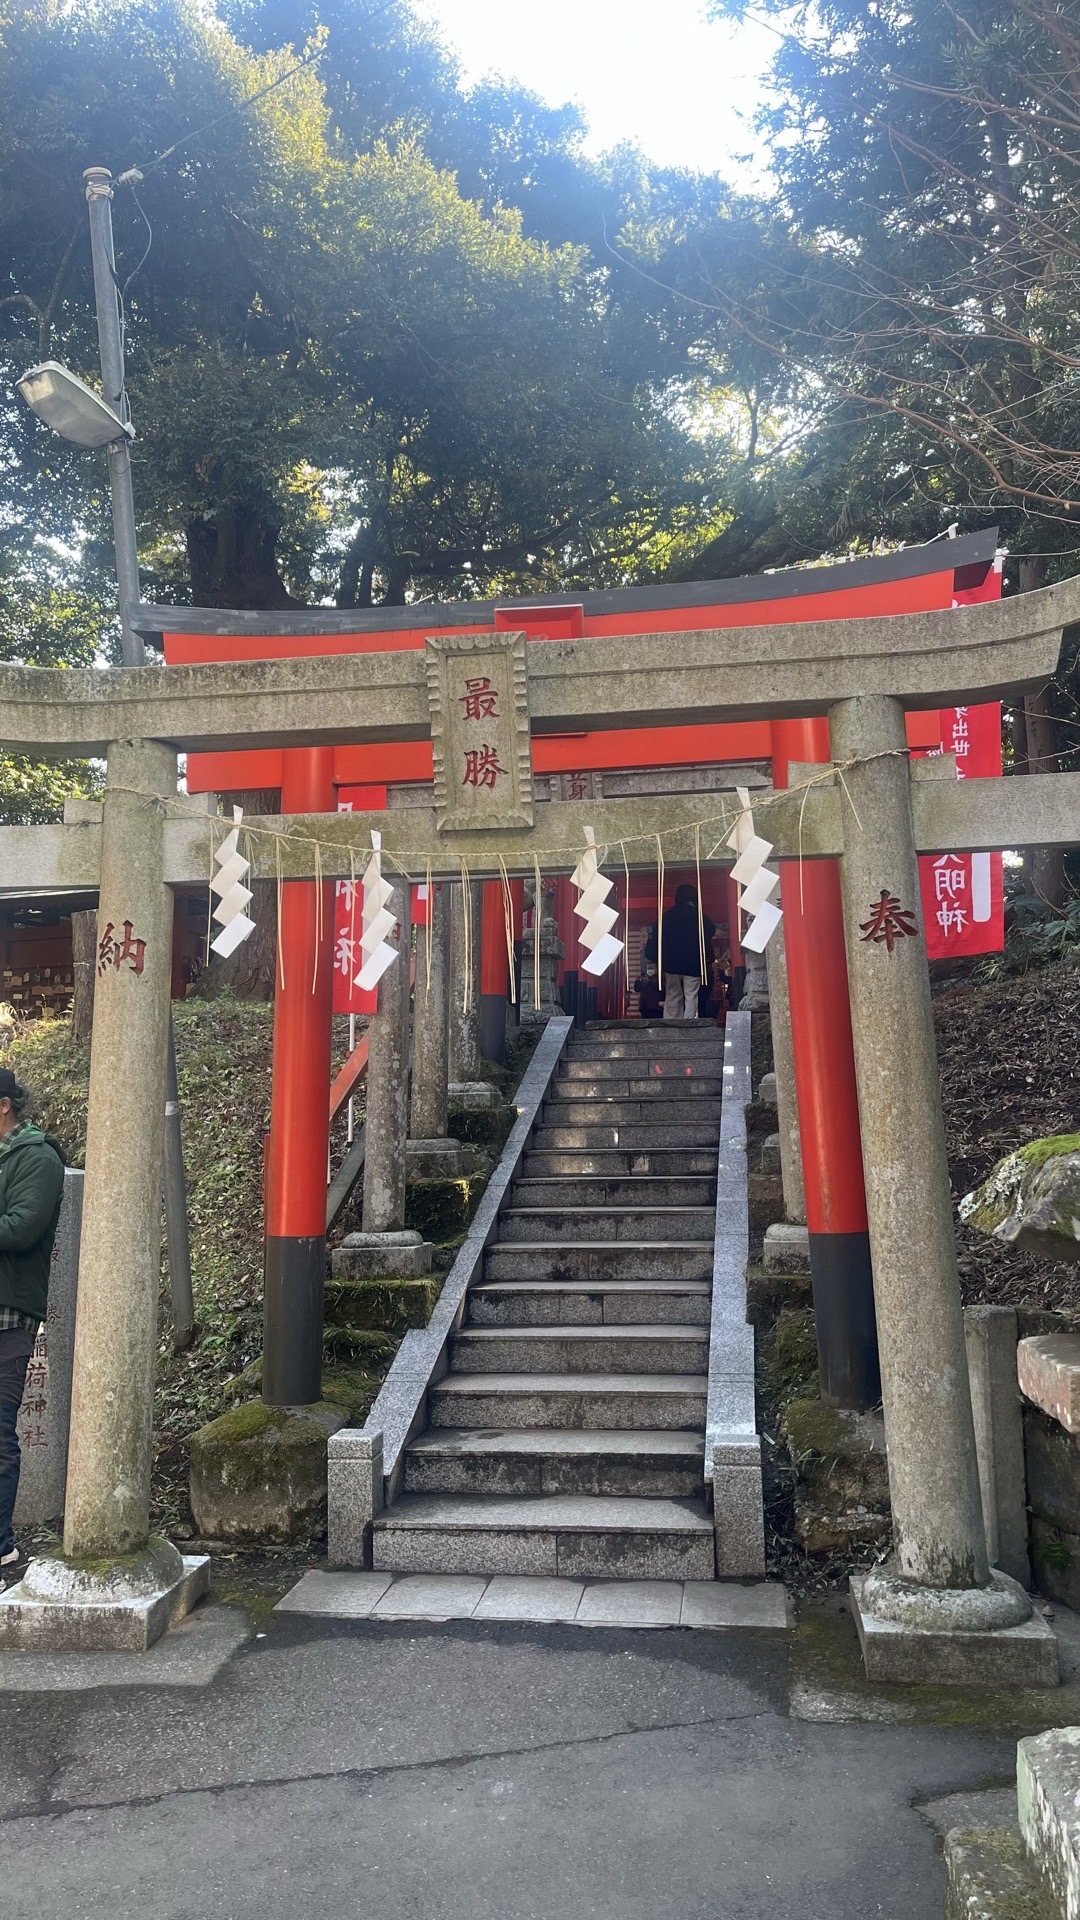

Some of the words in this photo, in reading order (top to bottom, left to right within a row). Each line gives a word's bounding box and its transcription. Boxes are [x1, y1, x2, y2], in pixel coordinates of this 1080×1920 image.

[458, 677, 508, 788] 最勝
[98, 920, 147, 978] 納
[859, 889, 919, 954] 奉
